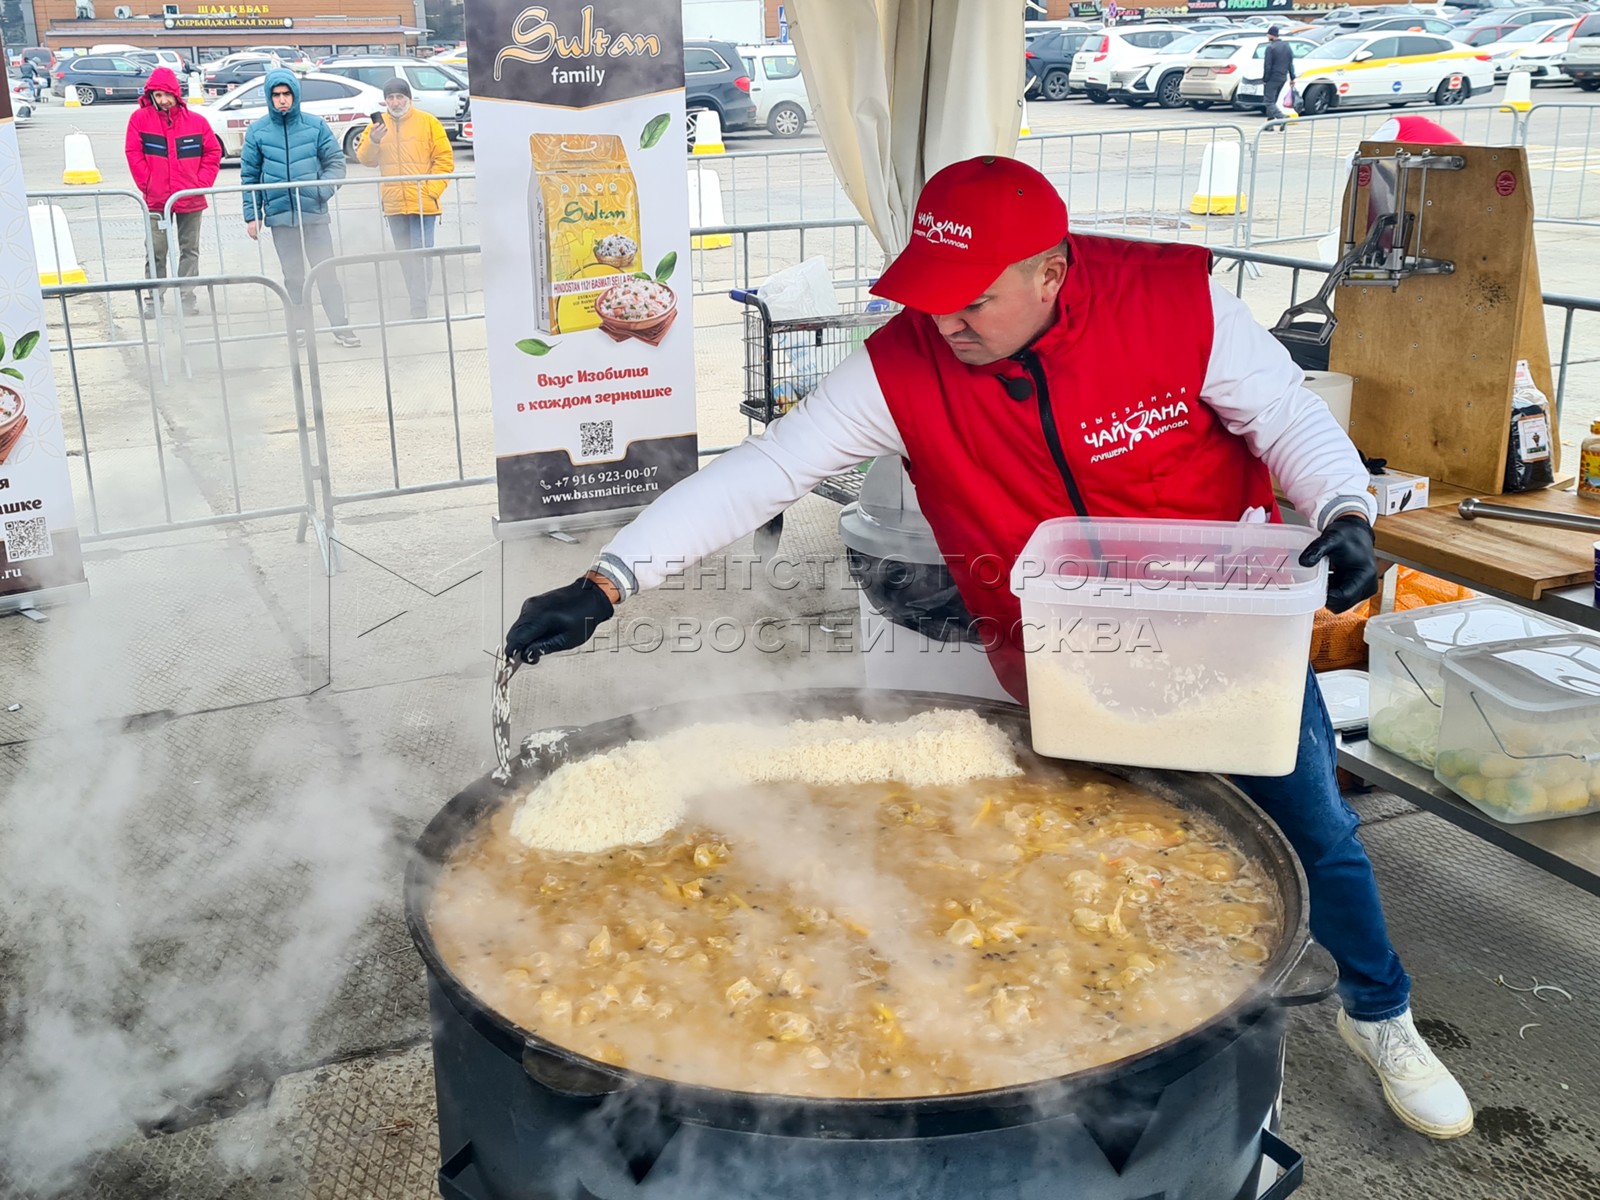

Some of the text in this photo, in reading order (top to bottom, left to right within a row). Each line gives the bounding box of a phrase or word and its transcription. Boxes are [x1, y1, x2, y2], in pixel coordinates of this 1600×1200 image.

[197, 4, 270, 14] ШАХ КЕБАБ
[175, 19, 283, 27] АЗЕРБАЙДЖАНСКАЯ КУХНЯ
[494, 5, 661, 81] Sultan
[551, 65, 605, 86] family
[557, 200, 625, 231] Sultan
[553, 281, 580, 293] HINDOSTAN
[591, 276, 611, 289] BASMATI
[537, 366, 649, 388] Вкус Изобилия
[517, 386, 673, 412] в каждом зернышке
[1080, 386, 1187, 430] ВЫЕЗДНАЯ
[555, 466, 659, 488] +7 916 923-00-07
[542, 481, 659, 504] www.basmatirice.ru
